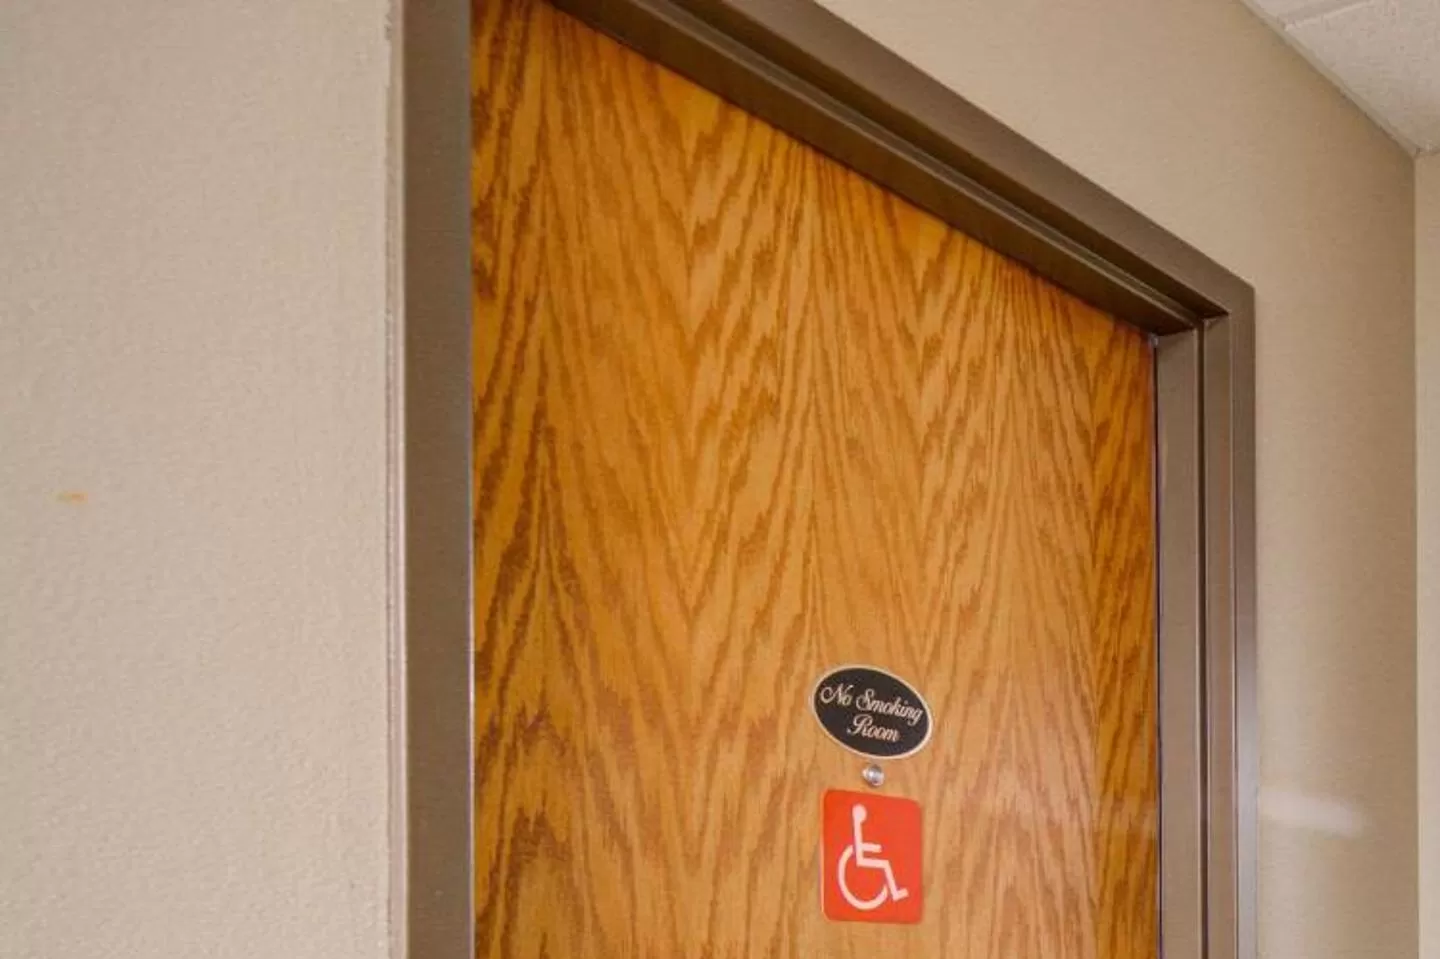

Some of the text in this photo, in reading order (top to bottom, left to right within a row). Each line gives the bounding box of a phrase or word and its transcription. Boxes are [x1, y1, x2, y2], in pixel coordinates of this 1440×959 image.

[820, 683, 924, 727] No Smoking
[846, 713, 901, 743] Room
